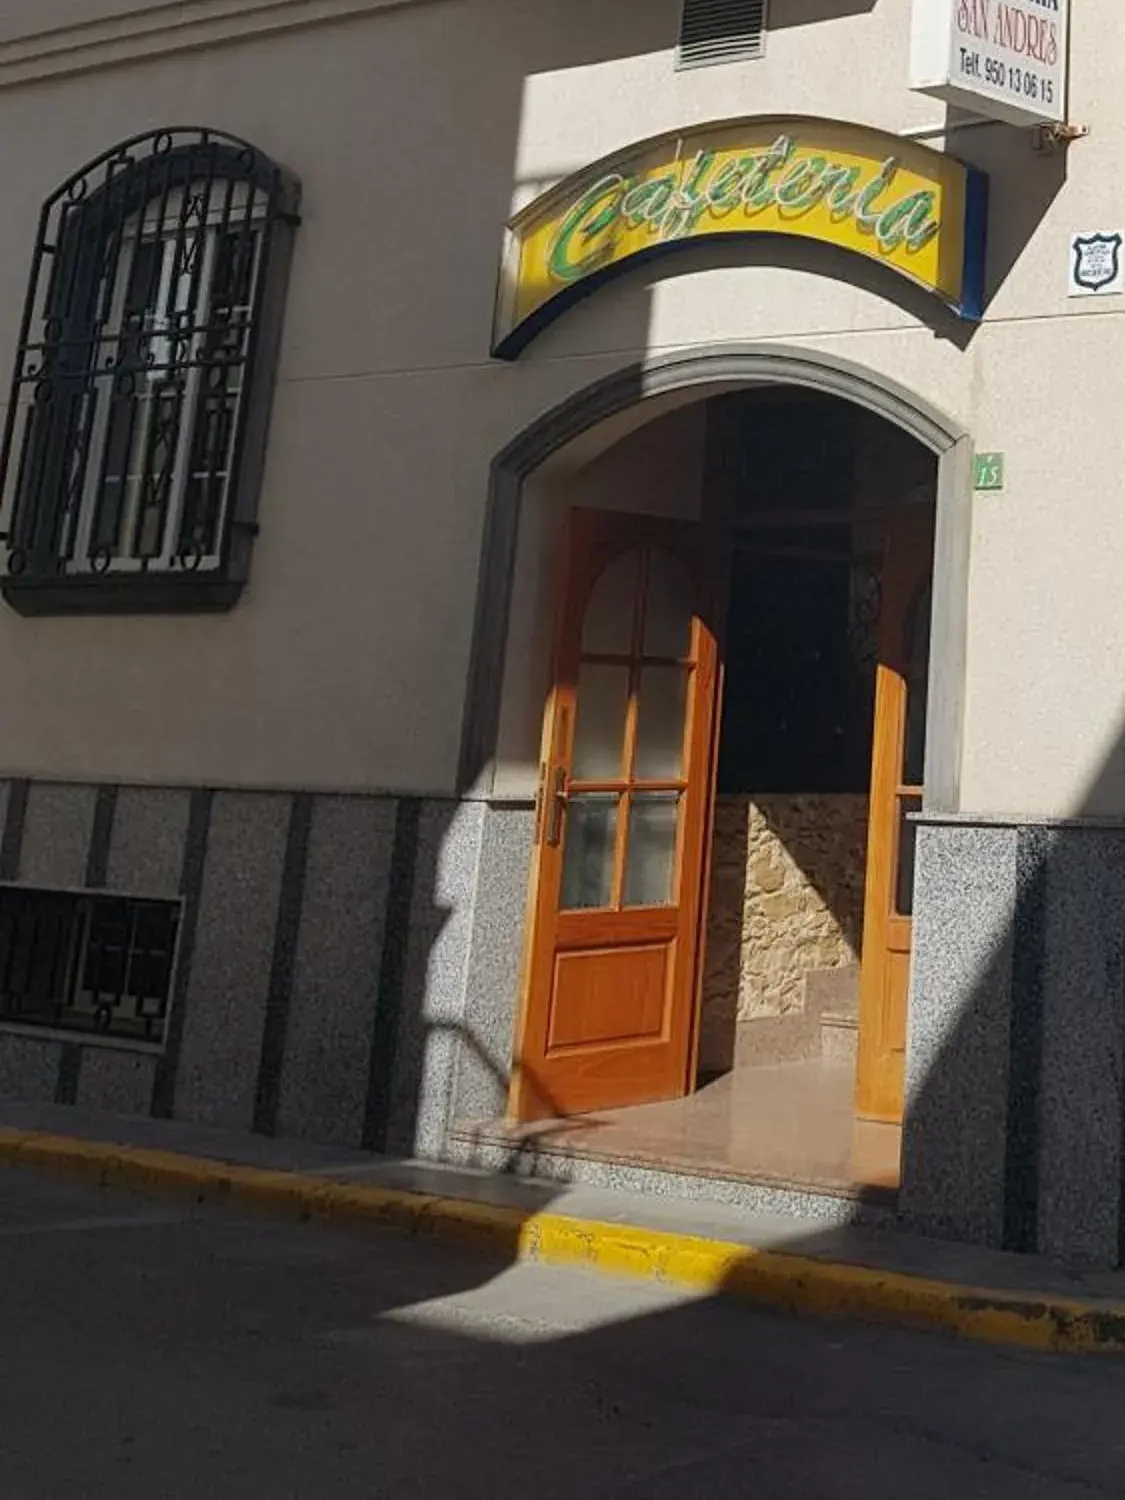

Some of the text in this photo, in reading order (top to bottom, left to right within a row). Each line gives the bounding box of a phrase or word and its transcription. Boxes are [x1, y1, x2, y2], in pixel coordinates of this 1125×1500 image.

[993, 2, 1057, 66] ANDRES
[985, 57, 1006, 87] 950
[1009, 67, 1021, 91] 13
[1041, 78, 1053, 104] 15
[548, 134, 941, 282] Cafeteria
